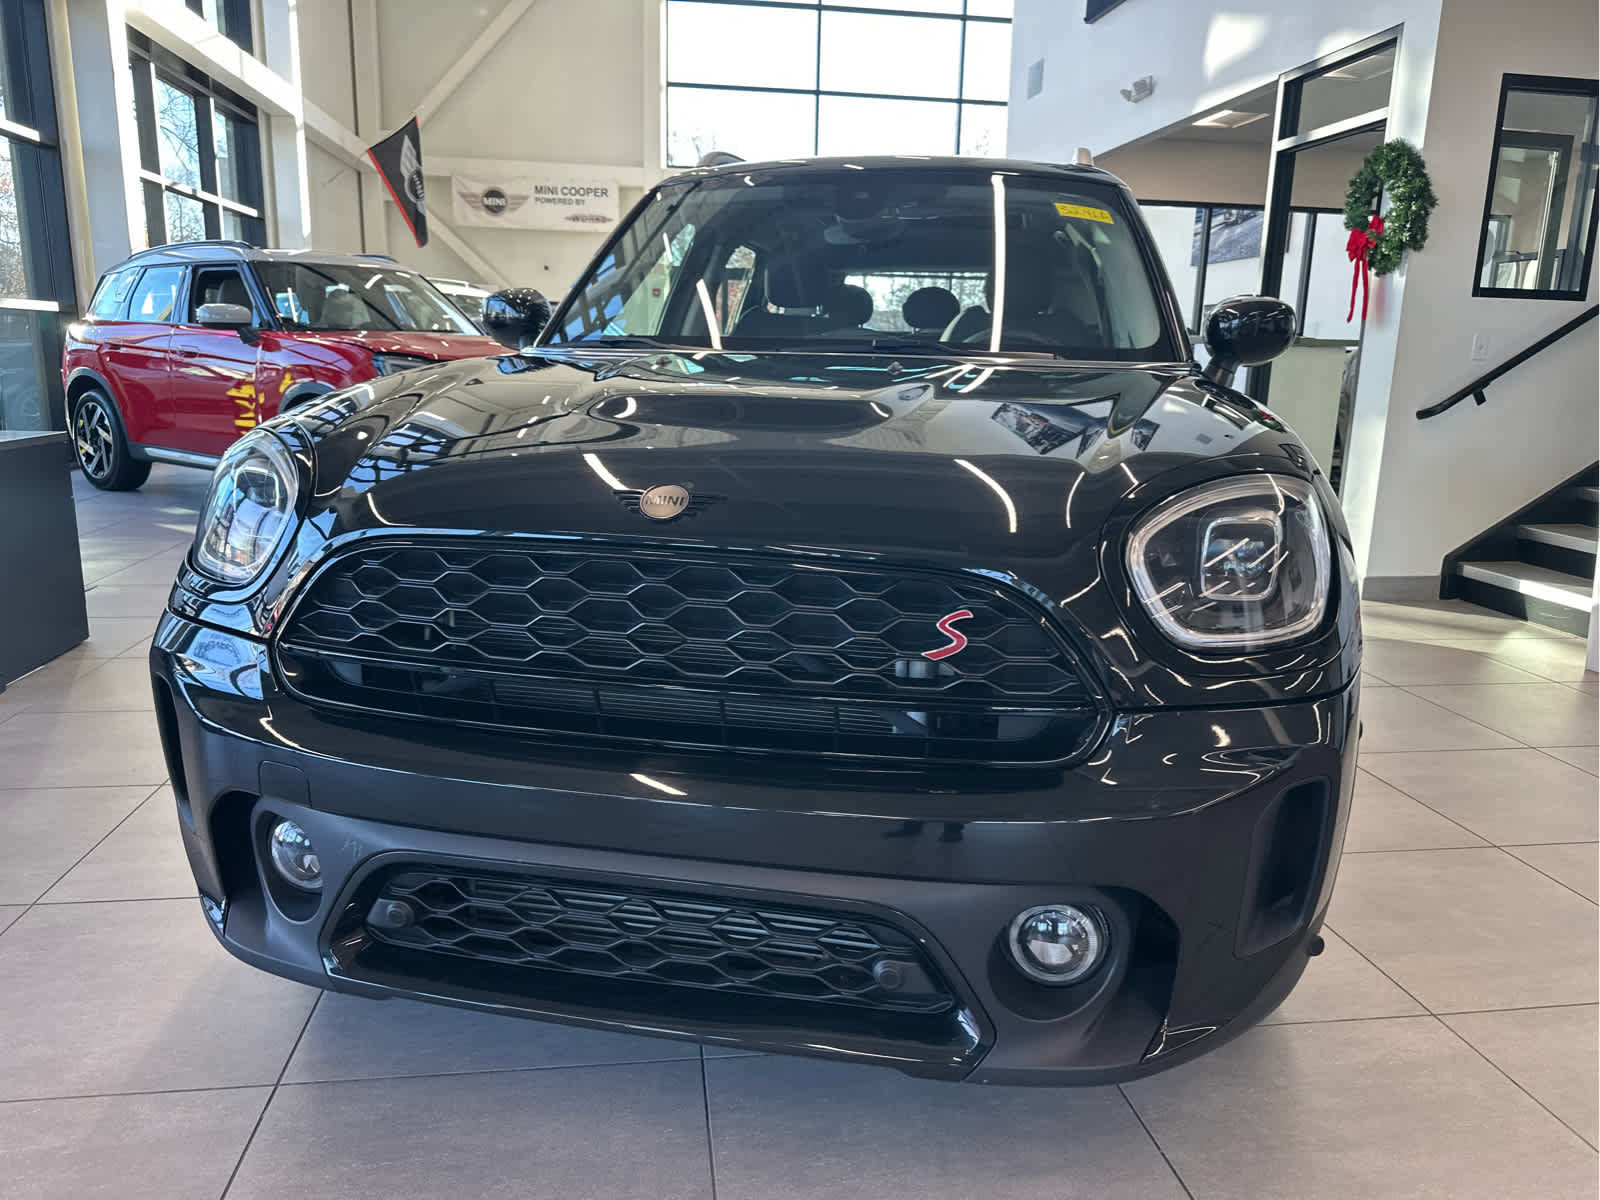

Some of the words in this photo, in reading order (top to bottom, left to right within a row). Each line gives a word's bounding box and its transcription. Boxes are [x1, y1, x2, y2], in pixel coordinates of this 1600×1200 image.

[534, 185, 558, 195] MINI
[561, 187, 609, 198] COOPER
[483, 197, 506, 207] MINI
[534, 197, 574, 206] POWERED
[645, 495, 685, 506] MINI
[920, 609, 974, 661] S
